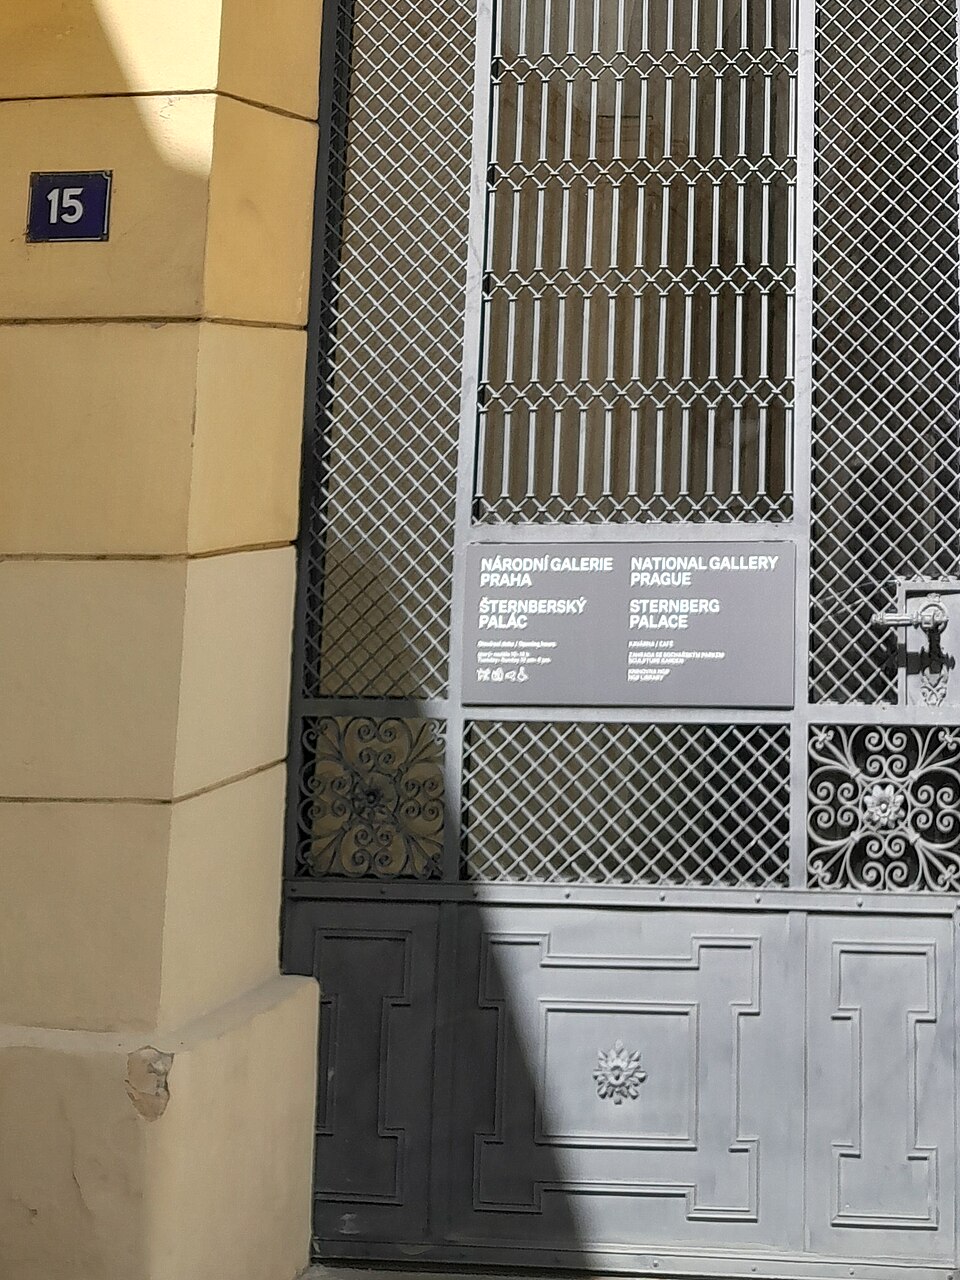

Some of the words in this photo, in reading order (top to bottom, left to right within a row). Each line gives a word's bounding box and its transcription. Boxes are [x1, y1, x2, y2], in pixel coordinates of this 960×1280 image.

[46, 187, 84, 224] 15
[480, 554, 549, 572] NÁRODNÍ
[550, 557, 614, 572] GALERIE
[630, 556, 707, 571] NATIONAL
[708, 555, 779, 570] GALLERY
[480, 573, 532, 587] PRAHA
[630, 572, 692, 587] PRAGUE
[479, 596, 588, 615] ŠTERNBERSKÝ
[629, 598, 720, 614] STERNBERG
[479, 612, 529, 630] PALÁC
[629, 614, 689, 629] PALACE
